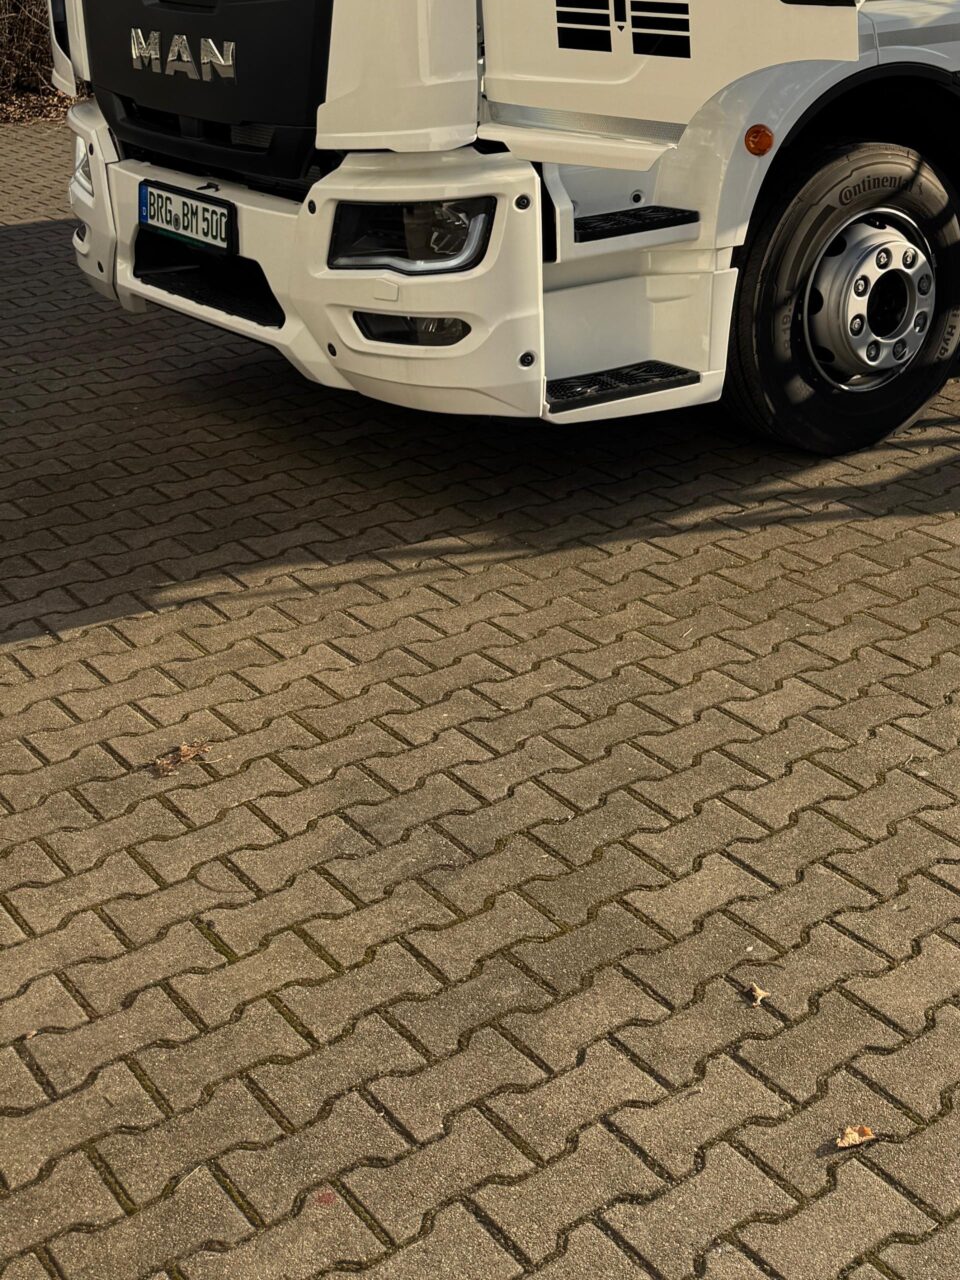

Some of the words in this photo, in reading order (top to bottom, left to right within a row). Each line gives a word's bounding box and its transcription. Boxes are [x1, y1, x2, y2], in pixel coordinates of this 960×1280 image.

[131, 28, 236, 82] MAN
[148, 190, 172, 227] BRG
[182, 200, 198, 235] BM
[838, 175, 913, 206] Continental
